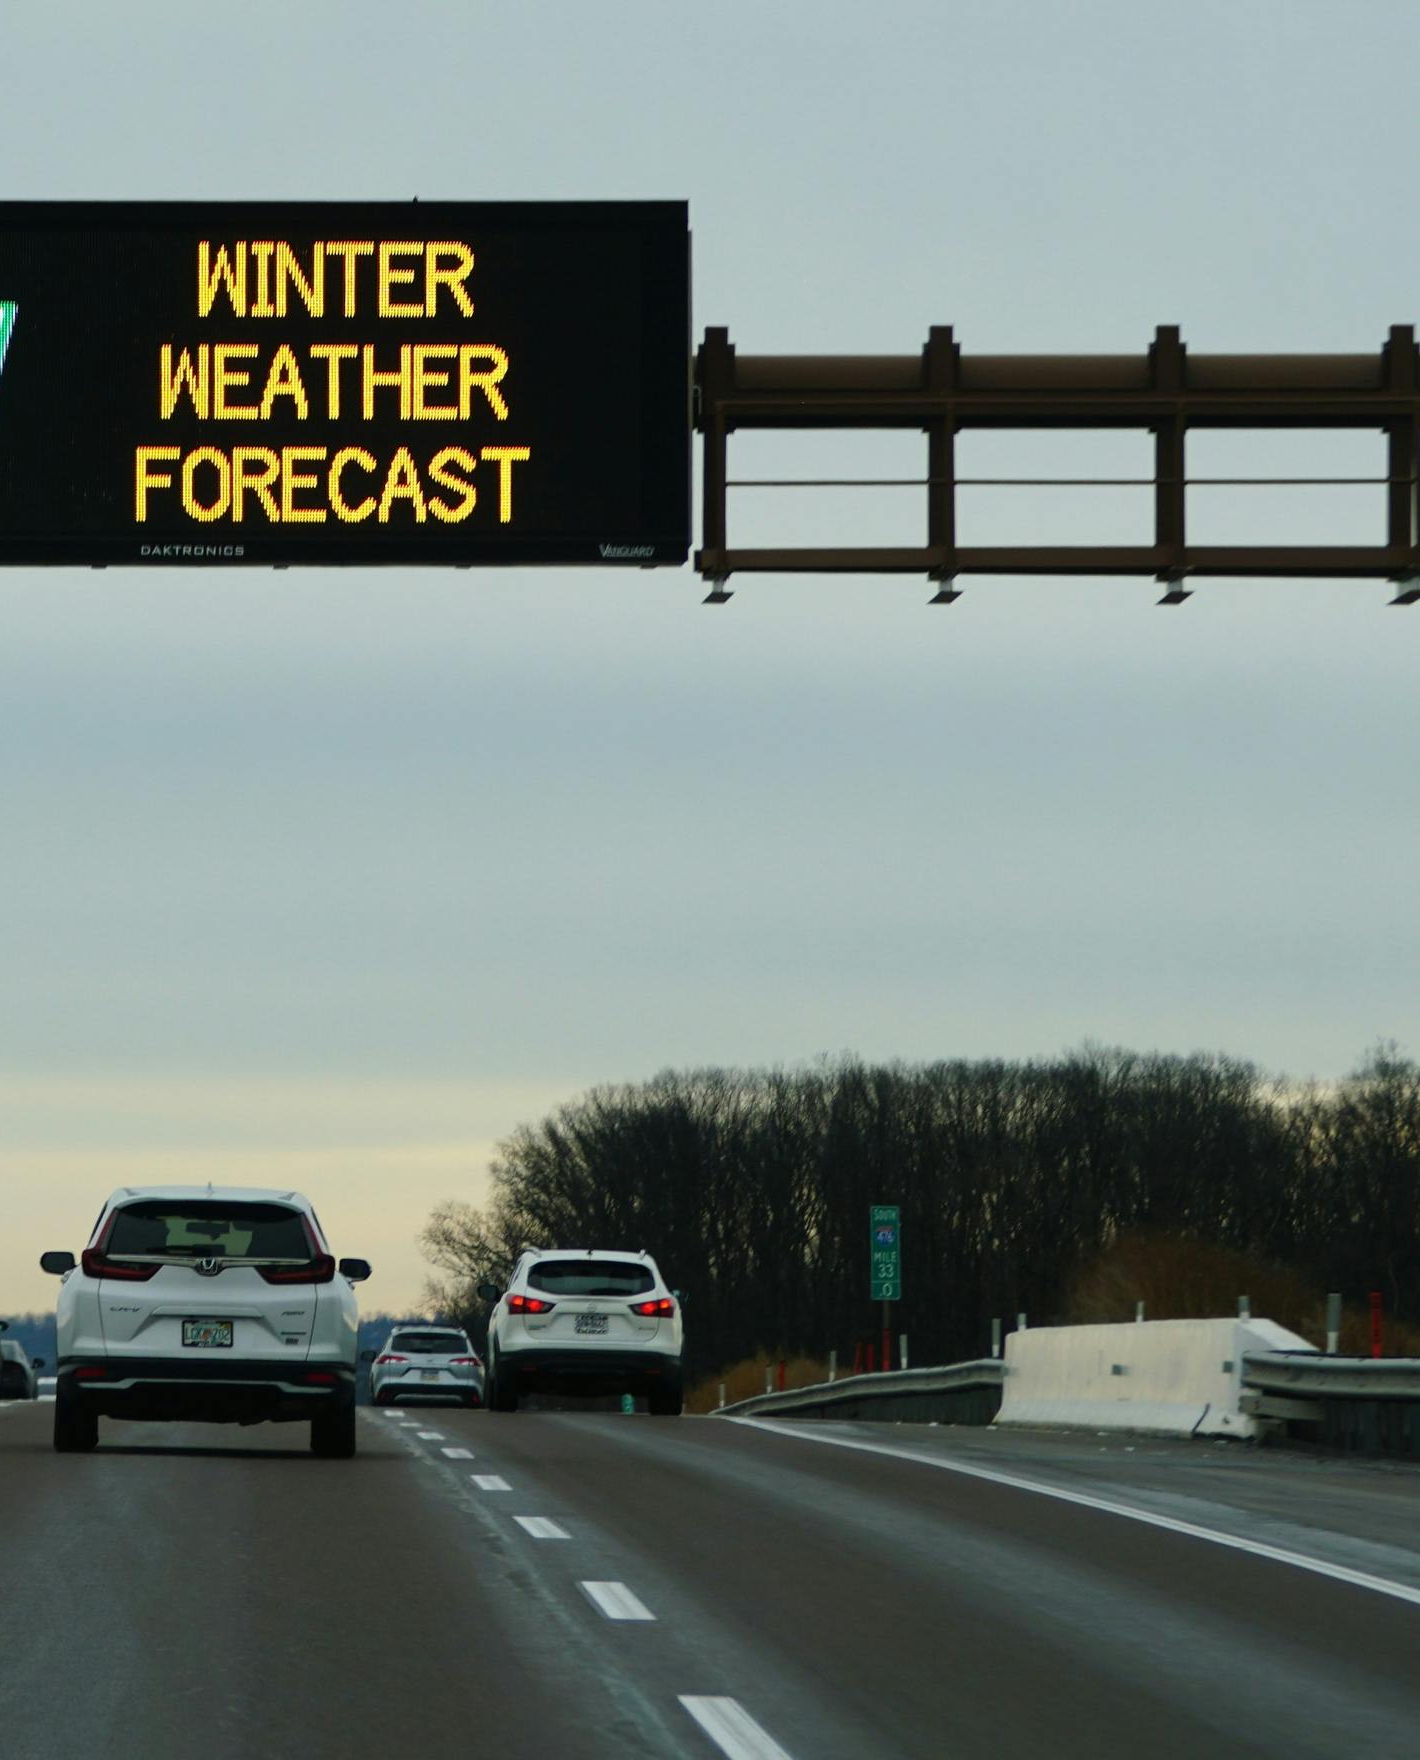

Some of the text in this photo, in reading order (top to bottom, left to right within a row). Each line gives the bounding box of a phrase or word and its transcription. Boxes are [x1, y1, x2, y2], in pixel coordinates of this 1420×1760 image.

[198, 241, 475, 318] WINTER
[160, 343, 509, 420] WEATHER
[135, 446, 530, 523] FORECAST
[140, 544, 245, 556] DAKTRONICS
[874, 1208, 897, 1220] SOUTH
[874, 1251, 897, 1262] MILE
[878, 1263, 894, 1278] 33
